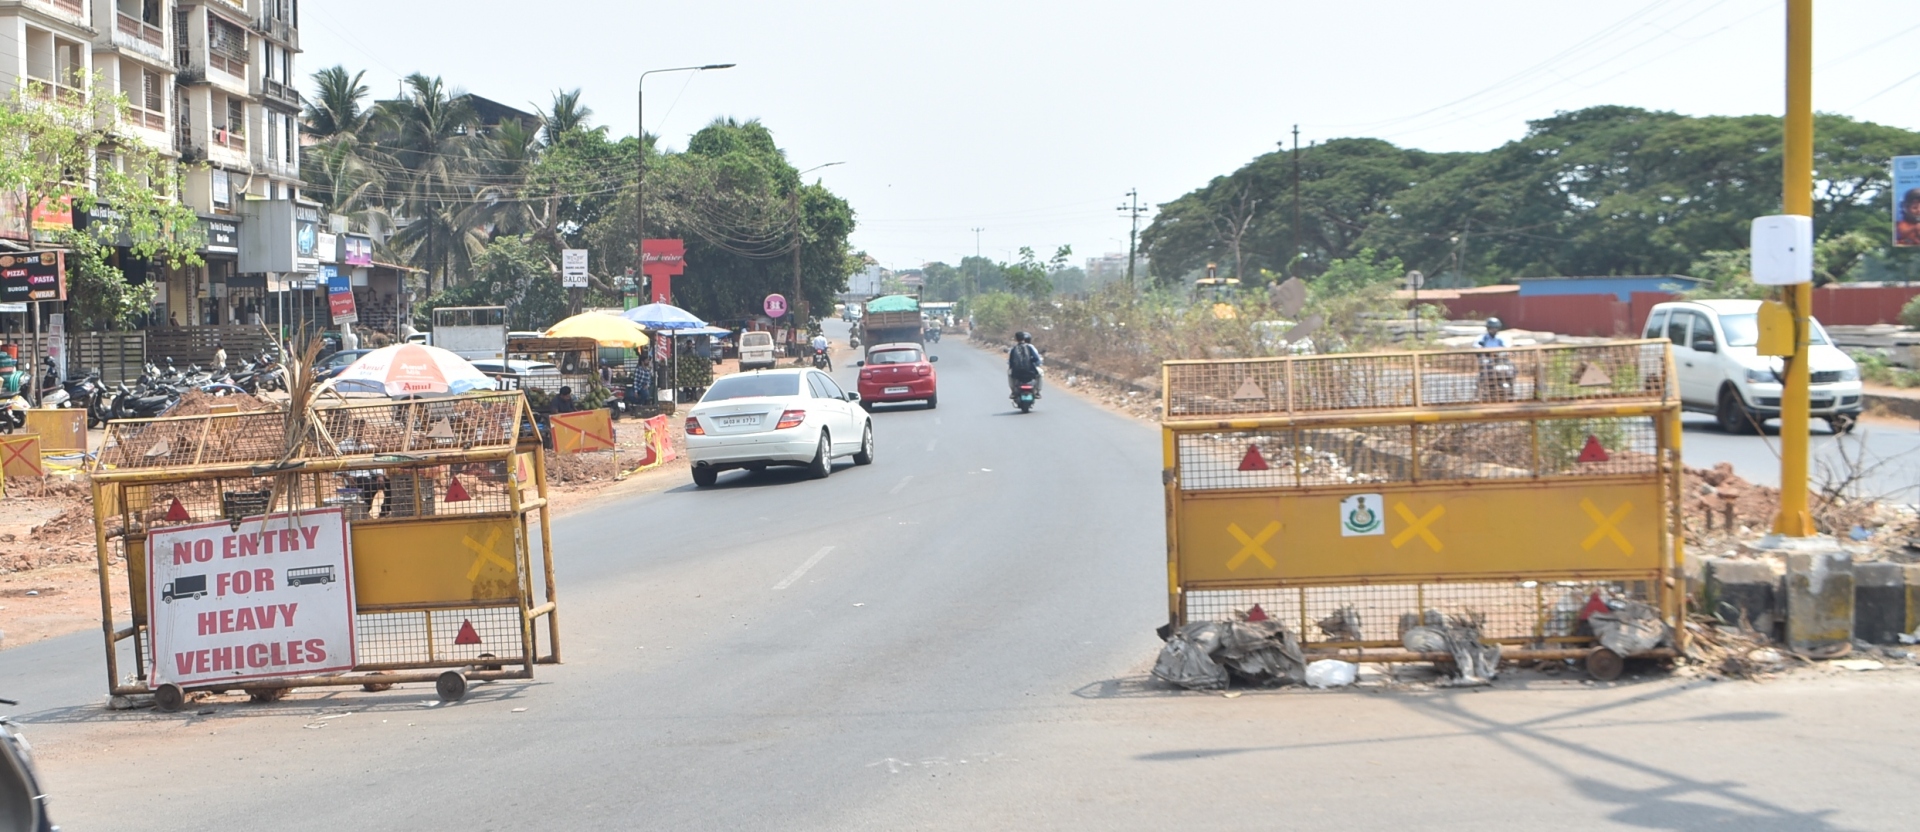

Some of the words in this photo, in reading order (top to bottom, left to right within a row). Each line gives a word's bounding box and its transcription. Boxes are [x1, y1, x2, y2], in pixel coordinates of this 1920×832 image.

[34, 275, 55, 283] PASTA
[36, 290, 55, 298] WRAP
[402, 382, 431, 391] Amul
[173, 538, 213, 565] NO
[222, 526, 320, 559] ENTRY
[216, 568, 275, 597] FOR
[198, 602, 298, 636] HEAVY
[175, 638, 327, 676] VEHICLES
